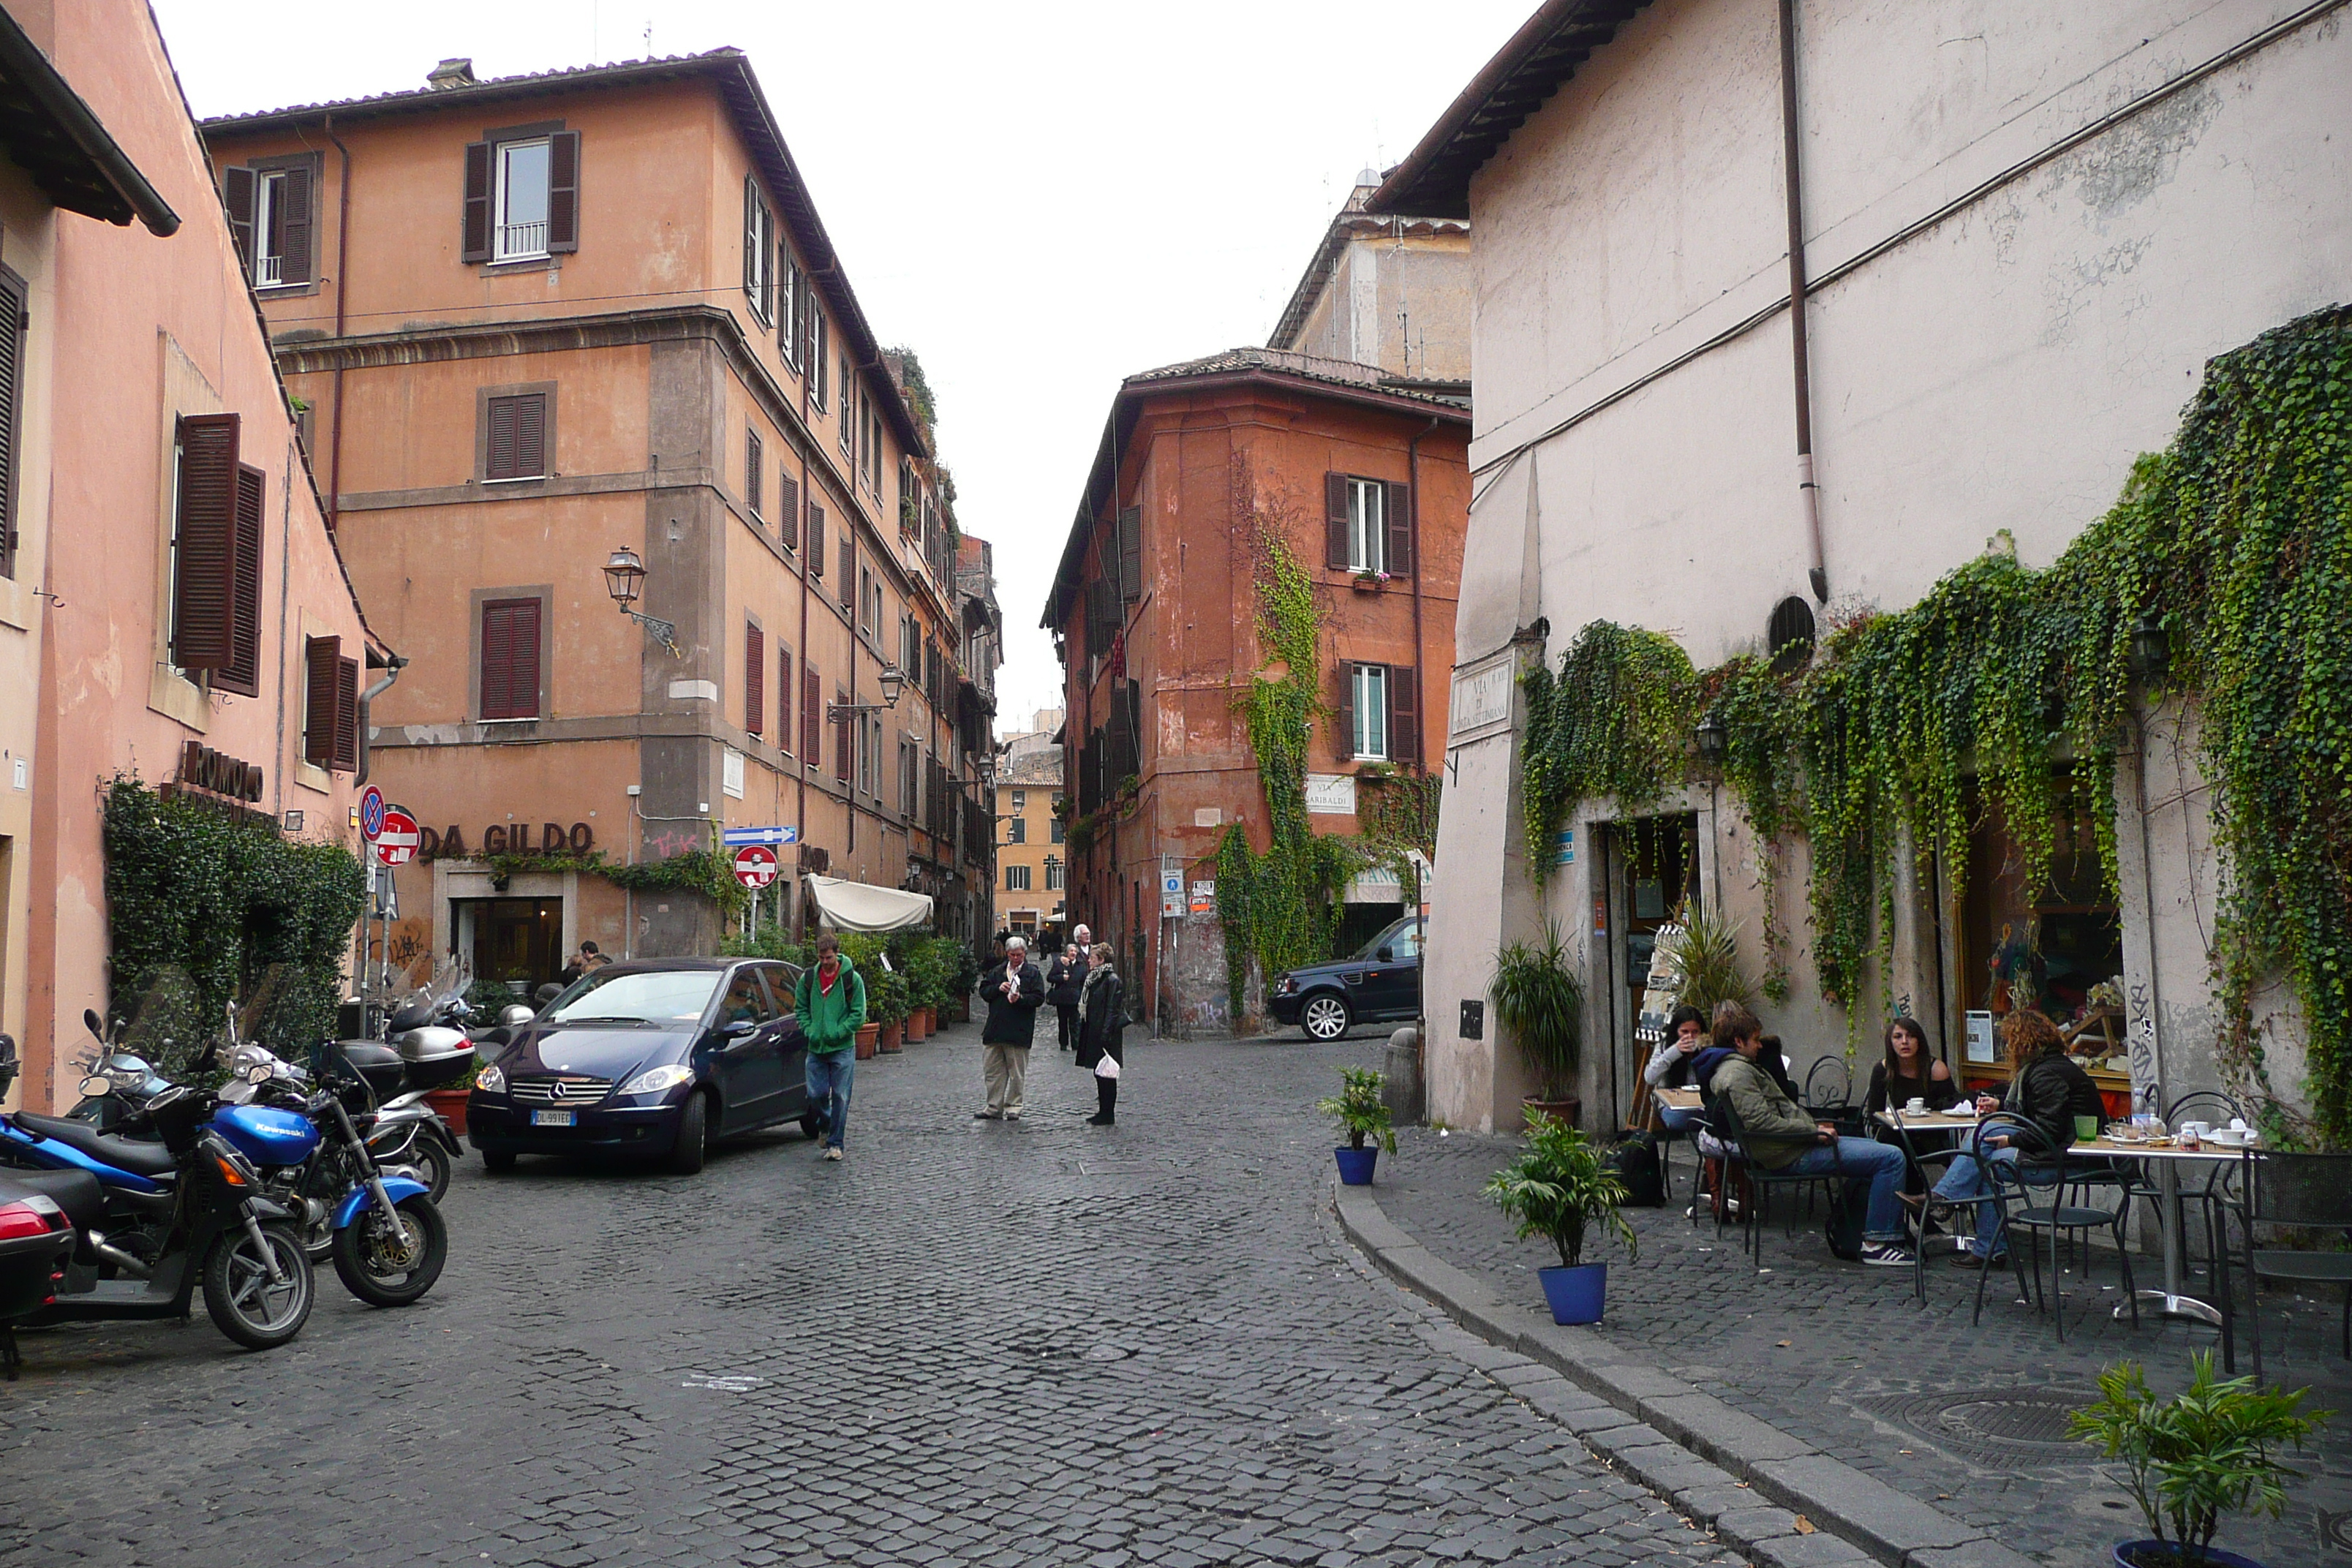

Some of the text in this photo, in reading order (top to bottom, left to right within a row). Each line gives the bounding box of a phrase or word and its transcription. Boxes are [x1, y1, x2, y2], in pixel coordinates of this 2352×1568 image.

[1474, 679, 1487, 695] VIA
[1476, 698, 1482, 709] DI
[417, 821, 593, 857] DA GILDO
[256, 1123, 306, 1137] Kawasaki
